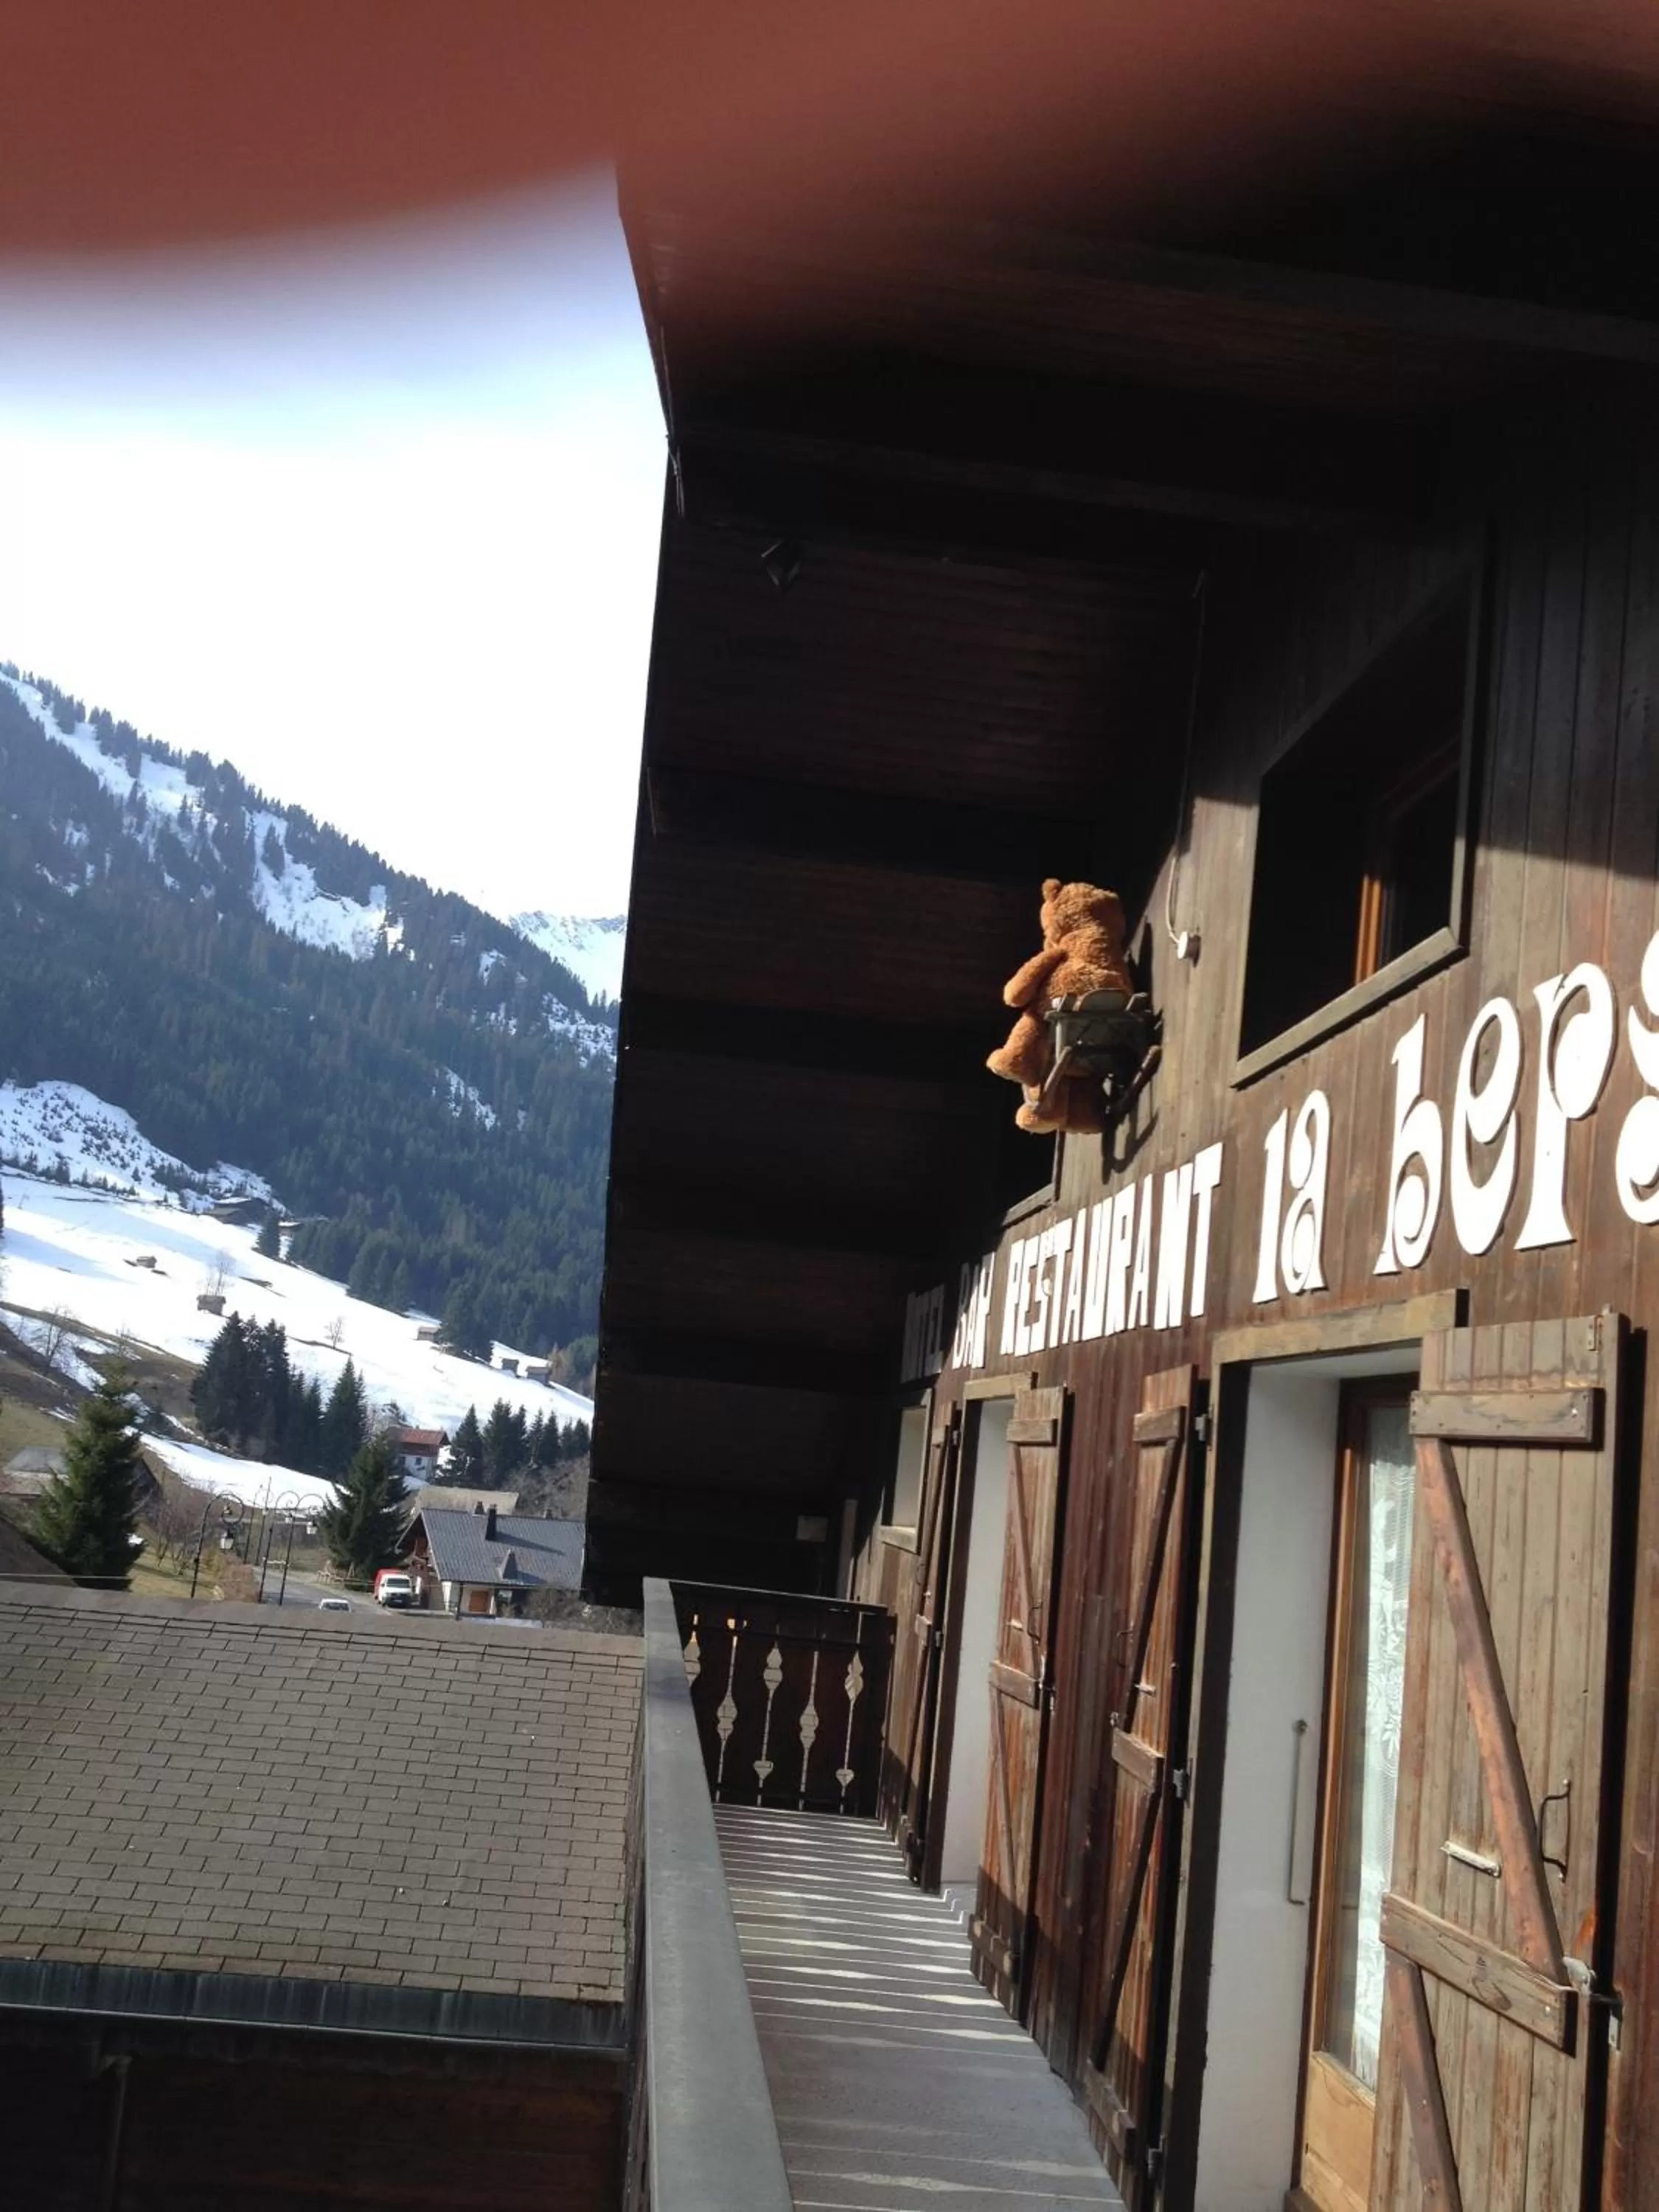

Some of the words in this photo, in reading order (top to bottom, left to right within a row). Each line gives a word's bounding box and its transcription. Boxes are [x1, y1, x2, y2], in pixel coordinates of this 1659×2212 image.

[952, 1251, 995, 1369] BAR
[1000, 1142, 1222, 1357] RESTAURANT
[1253, 1090, 1329, 1303] la
